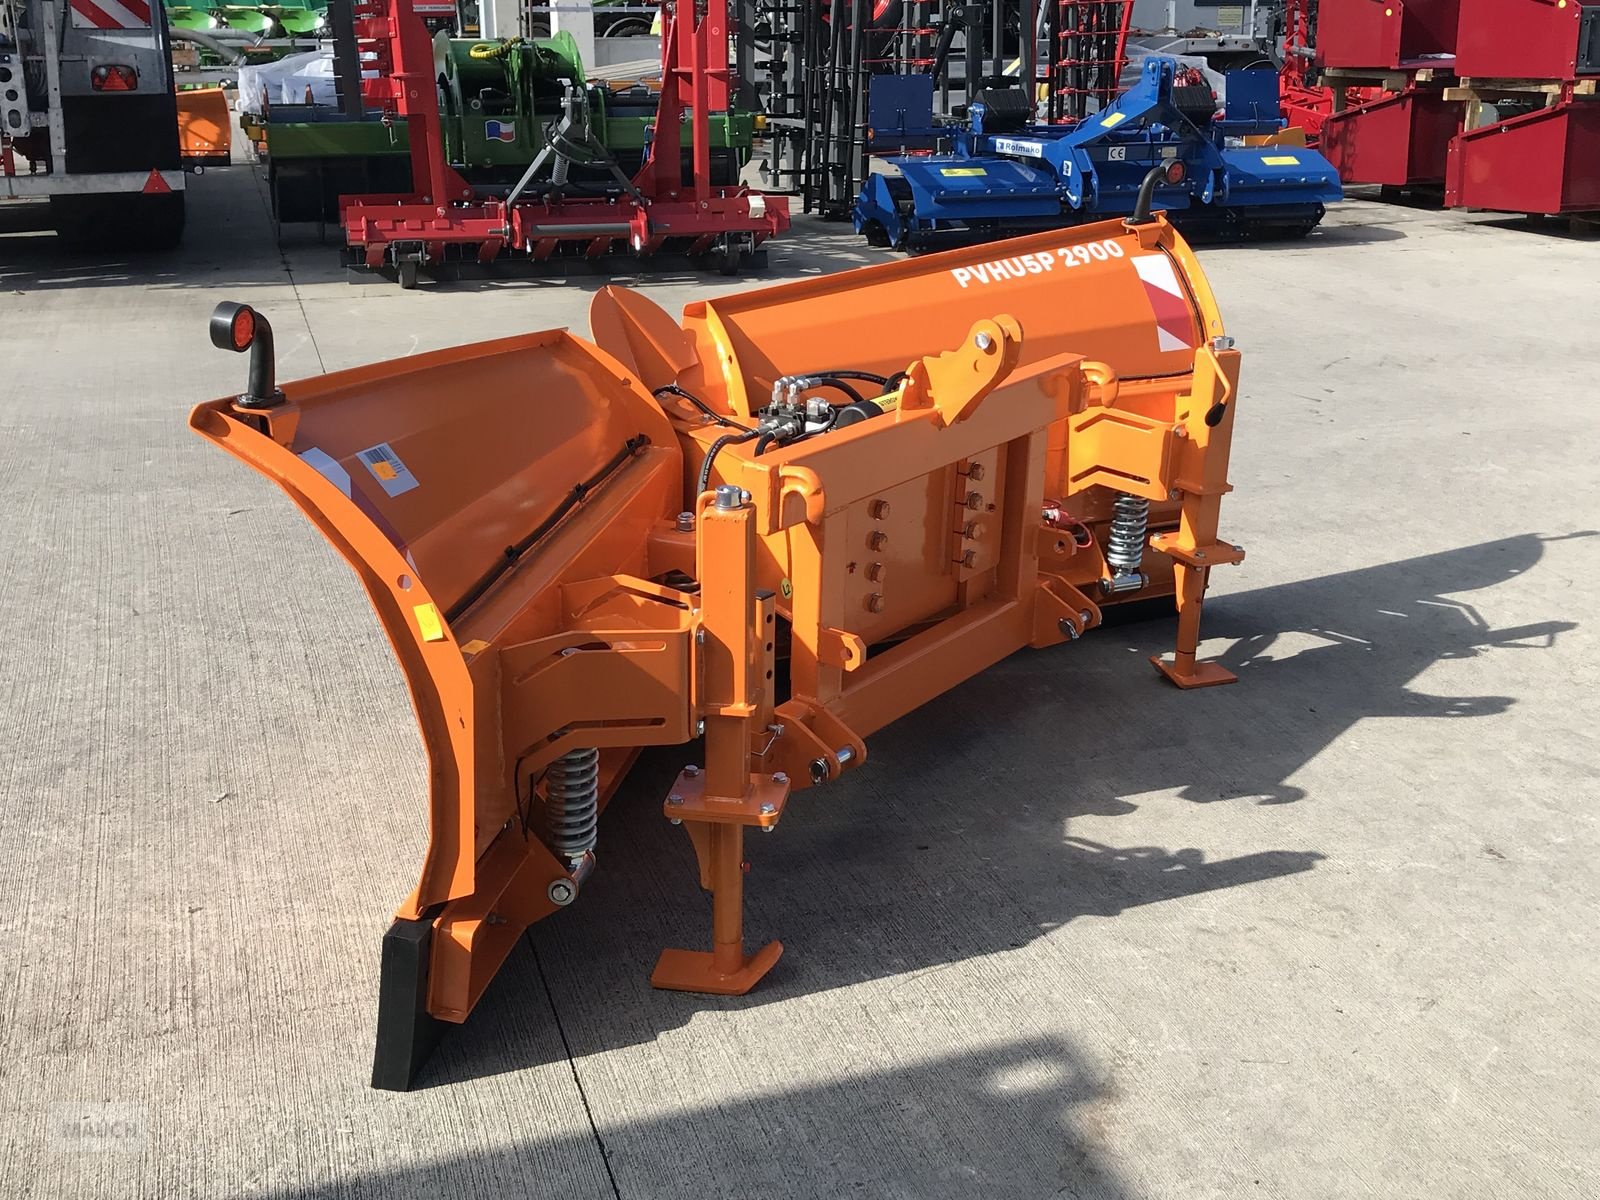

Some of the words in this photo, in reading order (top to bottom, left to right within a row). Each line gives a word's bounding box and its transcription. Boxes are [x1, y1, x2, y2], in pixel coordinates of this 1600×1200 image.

[1005, 142, 1040, 154] Rolmako
[1110, 148, 1124, 159] CE
[951, 252, 1055, 288] PVHU5P
[1057, 239, 1124, 267] 2900
